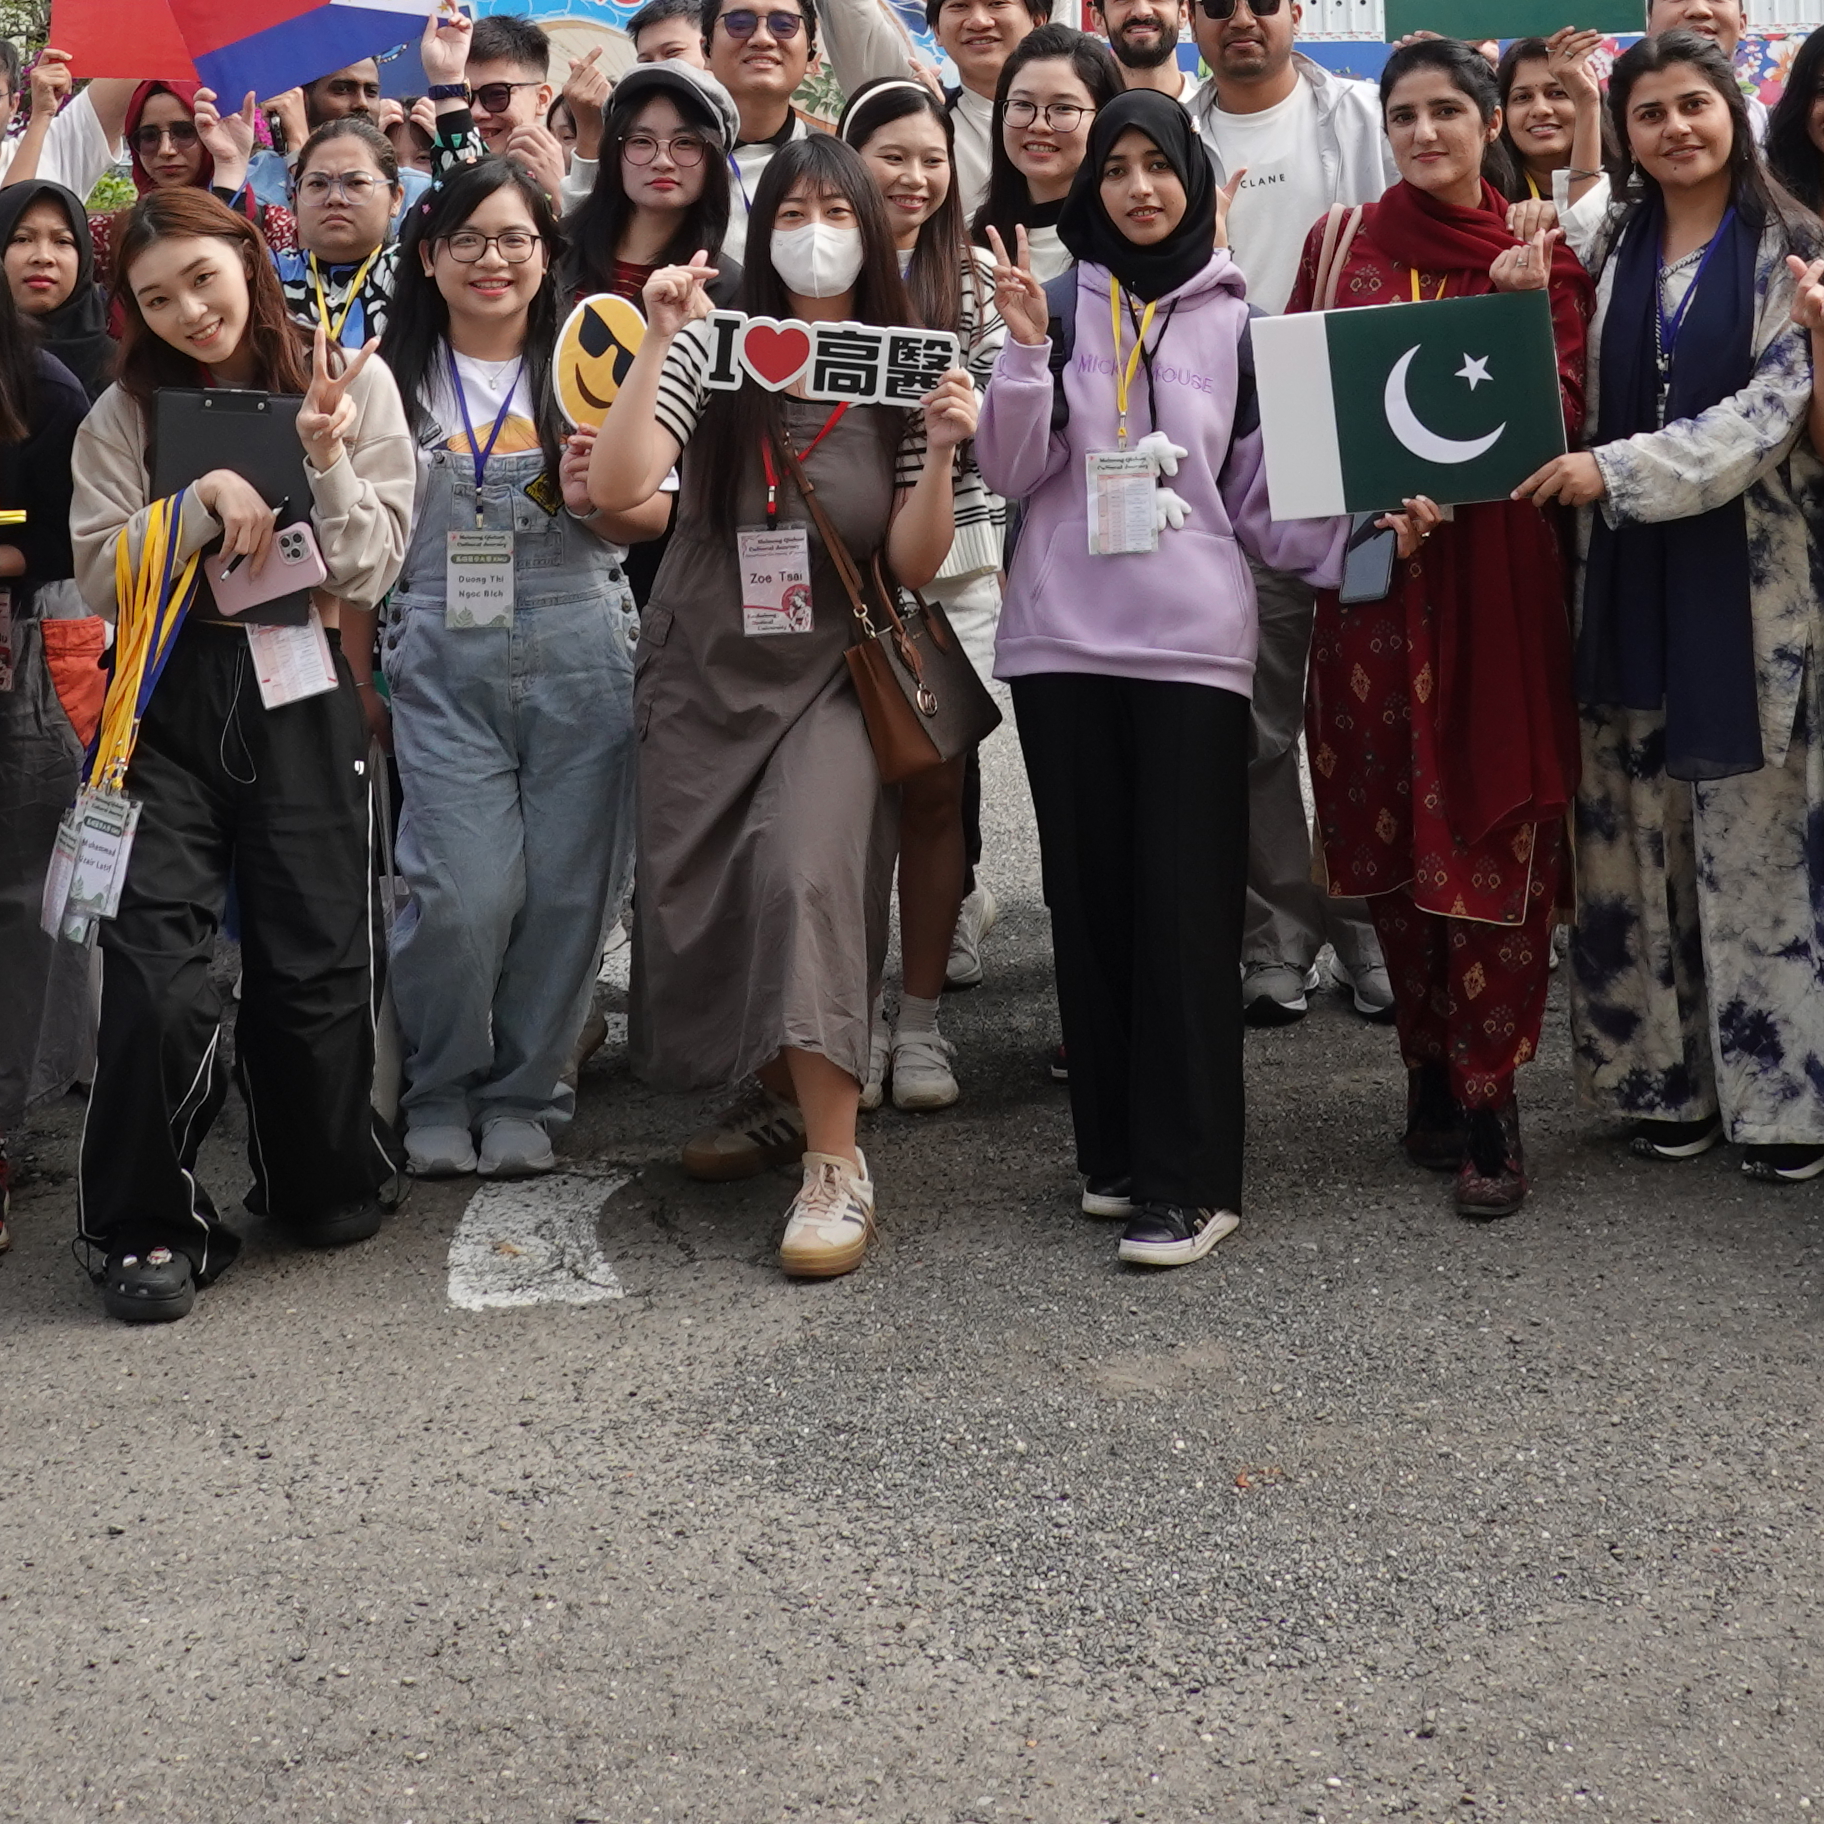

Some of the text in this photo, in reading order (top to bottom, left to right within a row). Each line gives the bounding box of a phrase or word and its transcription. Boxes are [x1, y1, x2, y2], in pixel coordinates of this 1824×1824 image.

[1240, 173, 1286, 189] CLANE
[708, 318, 954, 402] I 高醫
[1077, 354, 1147, 380] MICKY
[749, 570, 803, 584] Zoe Tsai
